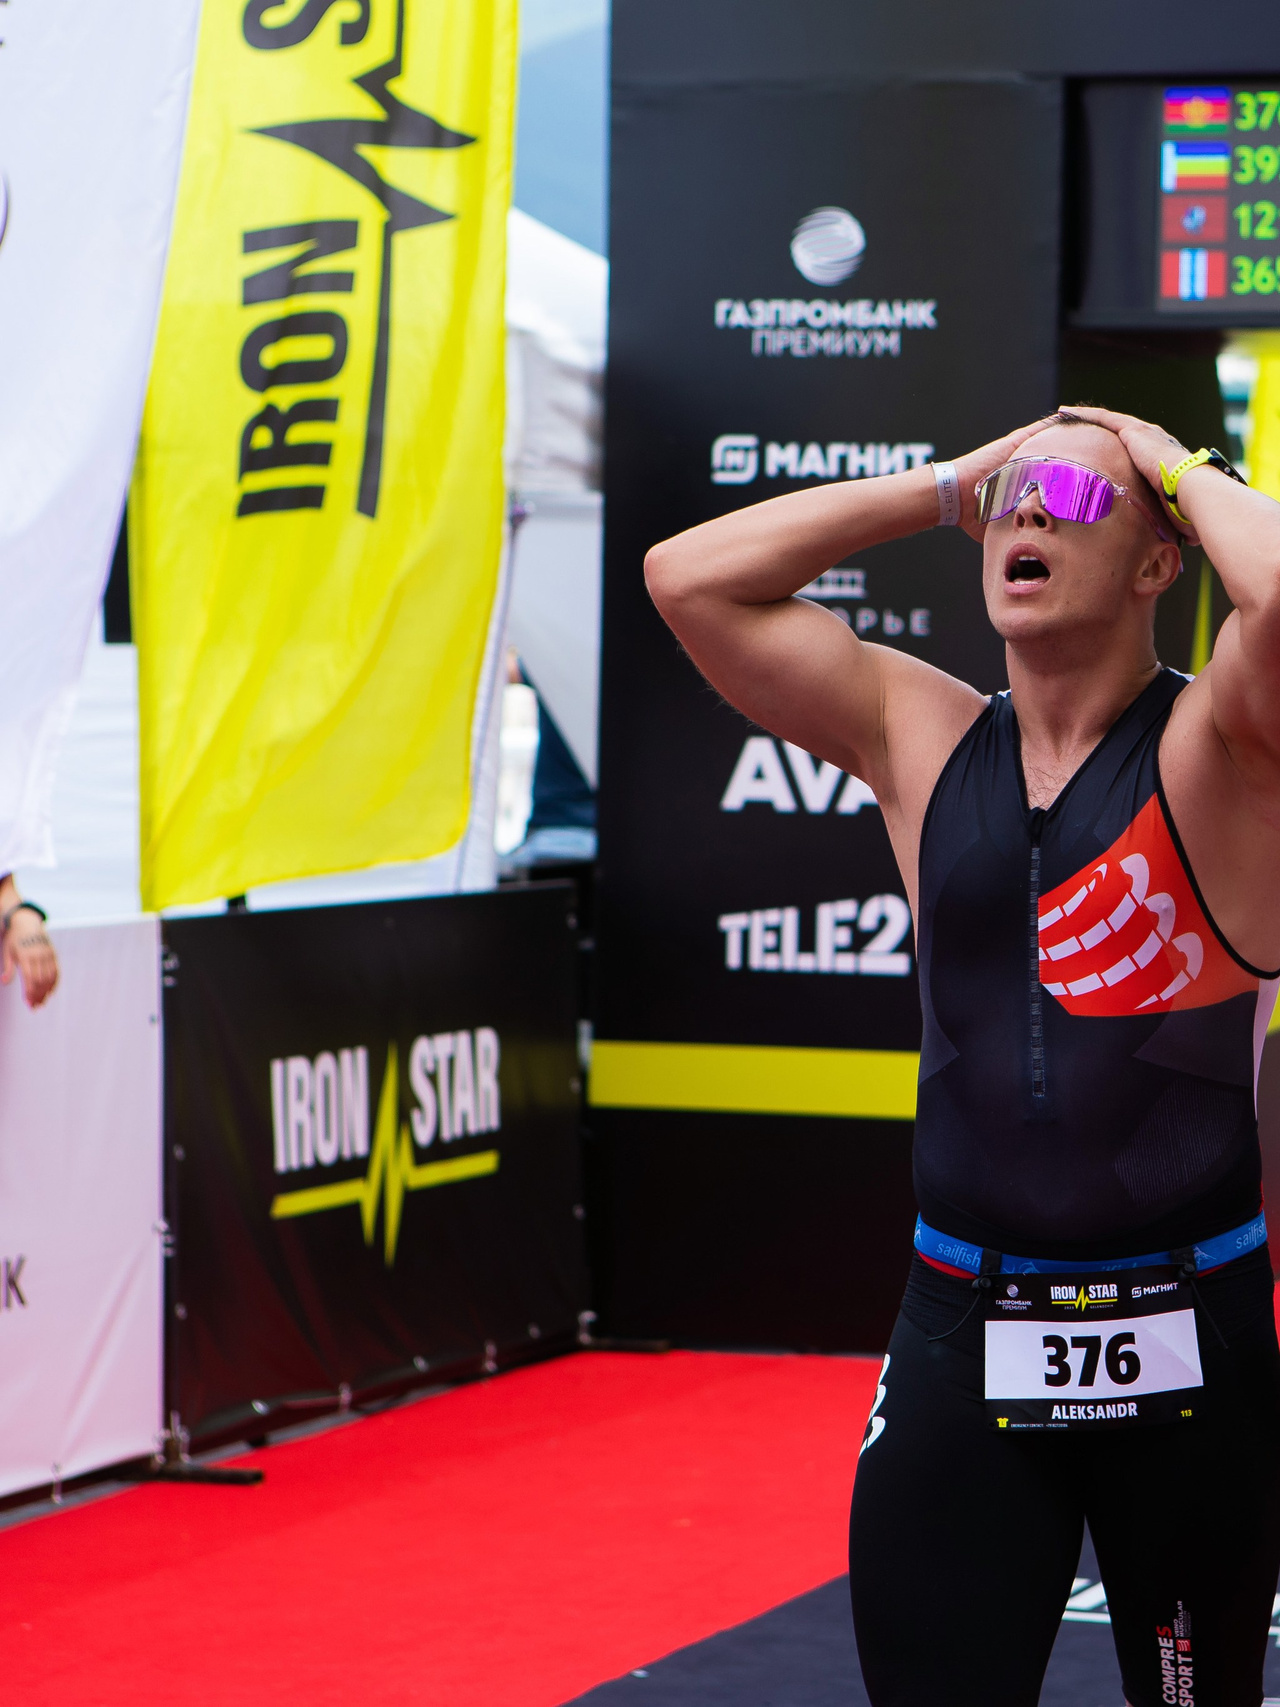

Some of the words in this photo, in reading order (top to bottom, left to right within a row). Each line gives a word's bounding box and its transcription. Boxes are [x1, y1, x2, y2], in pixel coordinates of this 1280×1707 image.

[715, 300, 937, 328] ГАЗПРОМБАНК
[751, 330, 900, 357] ПРЕМИУМ
[236, 219, 360, 519] IRON
[765, 442, 935, 478] МАГНИТ
[942, 478, 953, 504] ELITE
[719, 893, 912, 976] TELE2
[271, 1046, 369, 1174] IRON
[410, 1026, 500, 1147] STAR
[936, 1243, 981, 1268] sailfish
[1050, 1285, 1077, 1300] IRON
[1088, 1284, 1118, 1299] STAR
[1143, 1282, 1179, 1295] МАГНИТ
[1042, 1332, 1141, 1388] 376
[1051, 1402, 1138, 1420] ALEKSANDR
[1180, 1409, 1192, 1417] 113
[1156, 1625, 1177, 1705] COMPRES
[1177, 1653, 1194, 1707] SPORT
